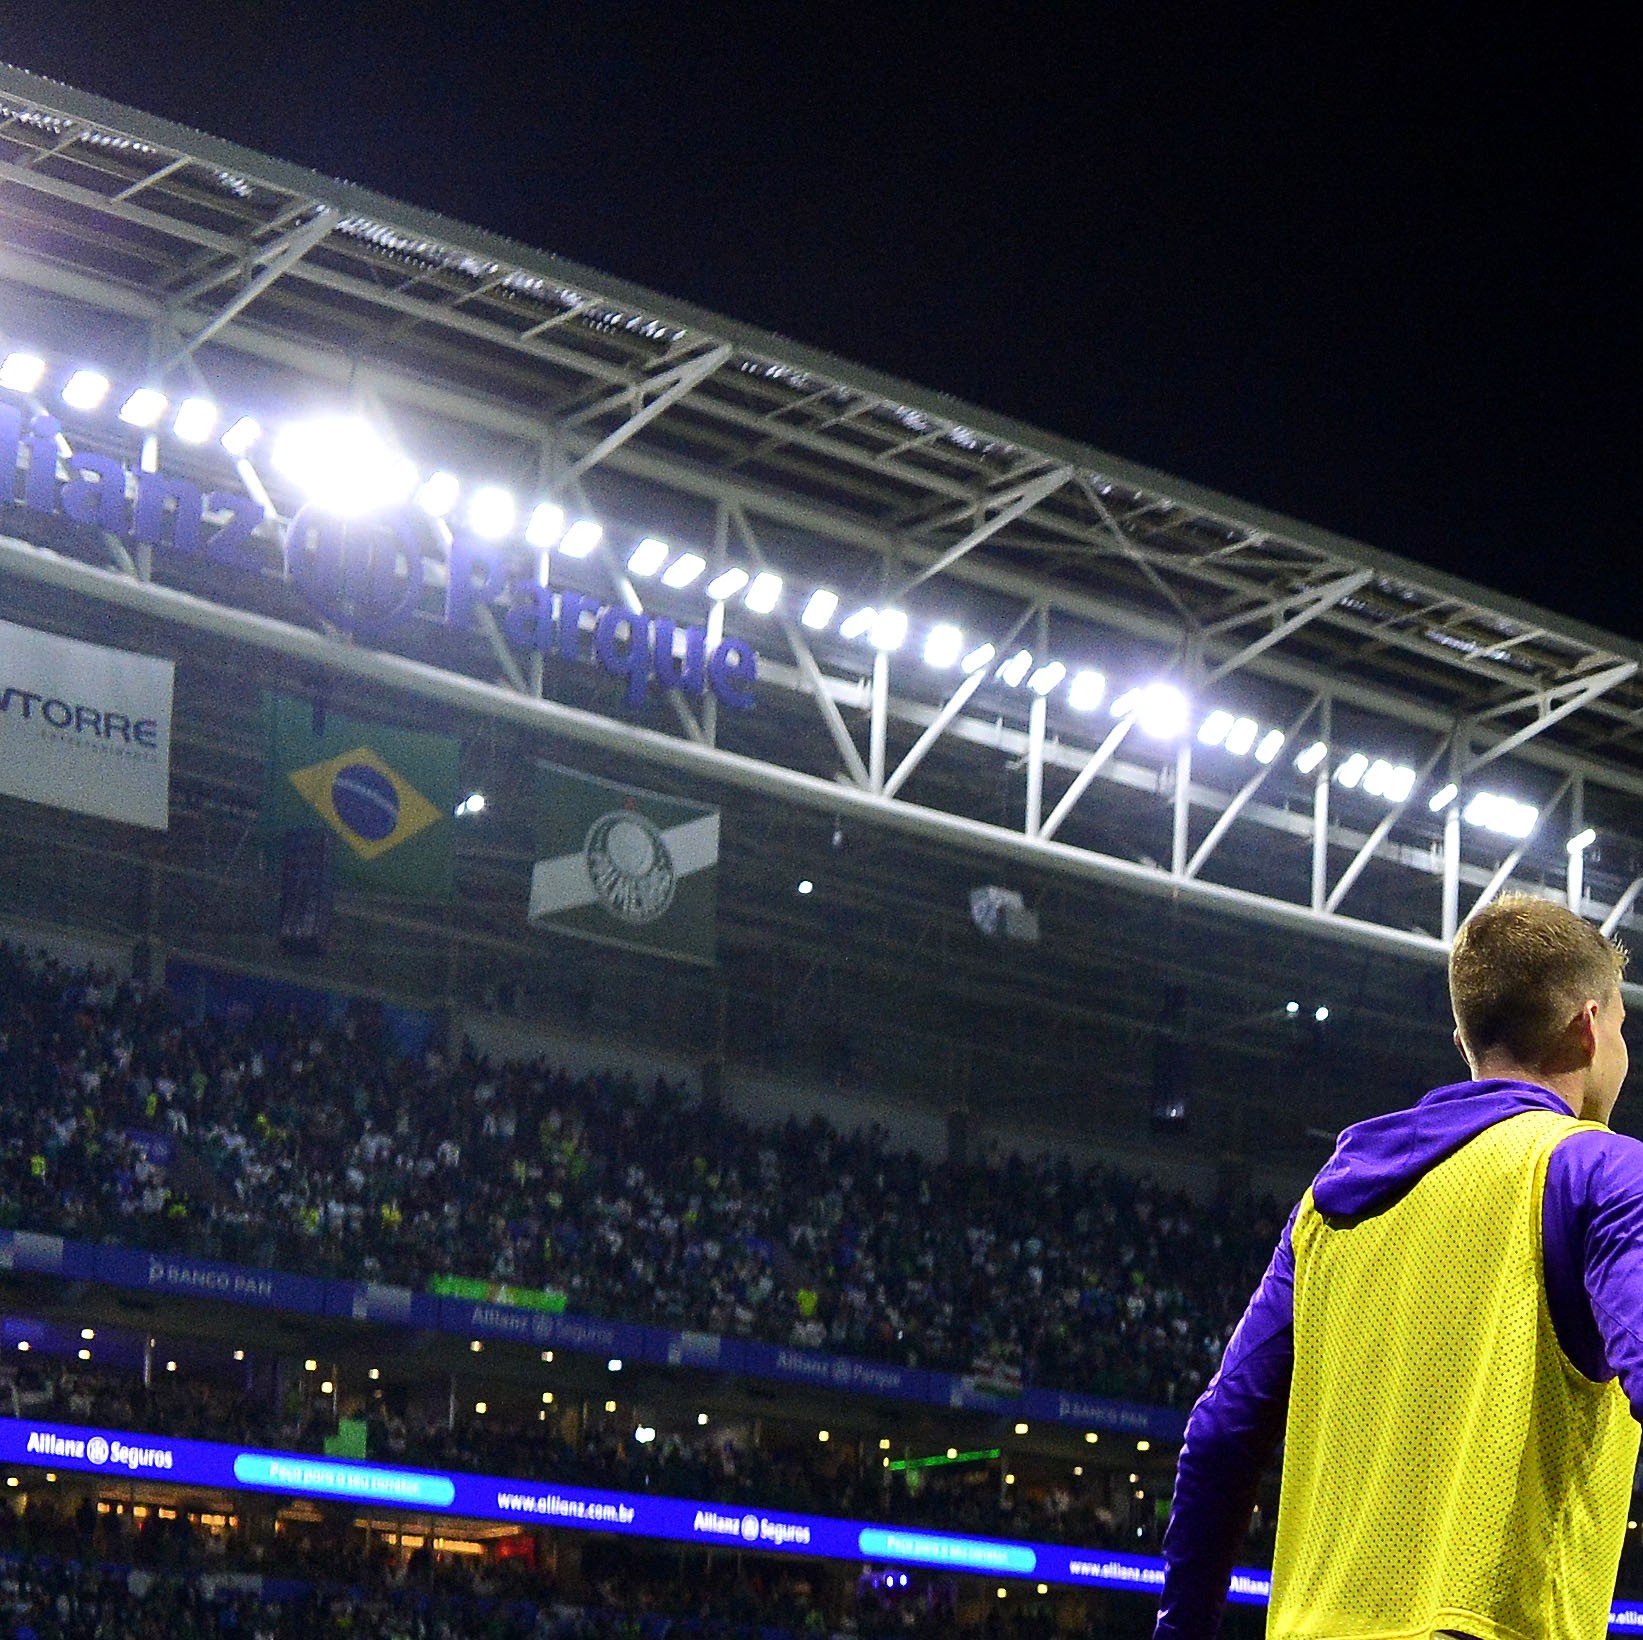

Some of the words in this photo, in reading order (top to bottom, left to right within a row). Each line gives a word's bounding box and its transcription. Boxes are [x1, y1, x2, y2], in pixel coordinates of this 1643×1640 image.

[449, 530, 758, 710] Parque
[0, 688, 157, 748] TORRE
[27, 1432, 85, 1459] Allianz
[110, 1441, 173, 1470] Seguros
[497, 1492, 635, 1524] www.allianz.com.br
[694, 1510, 740, 1536] Allianz
[760, 1518, 810, 1545] Seguros
